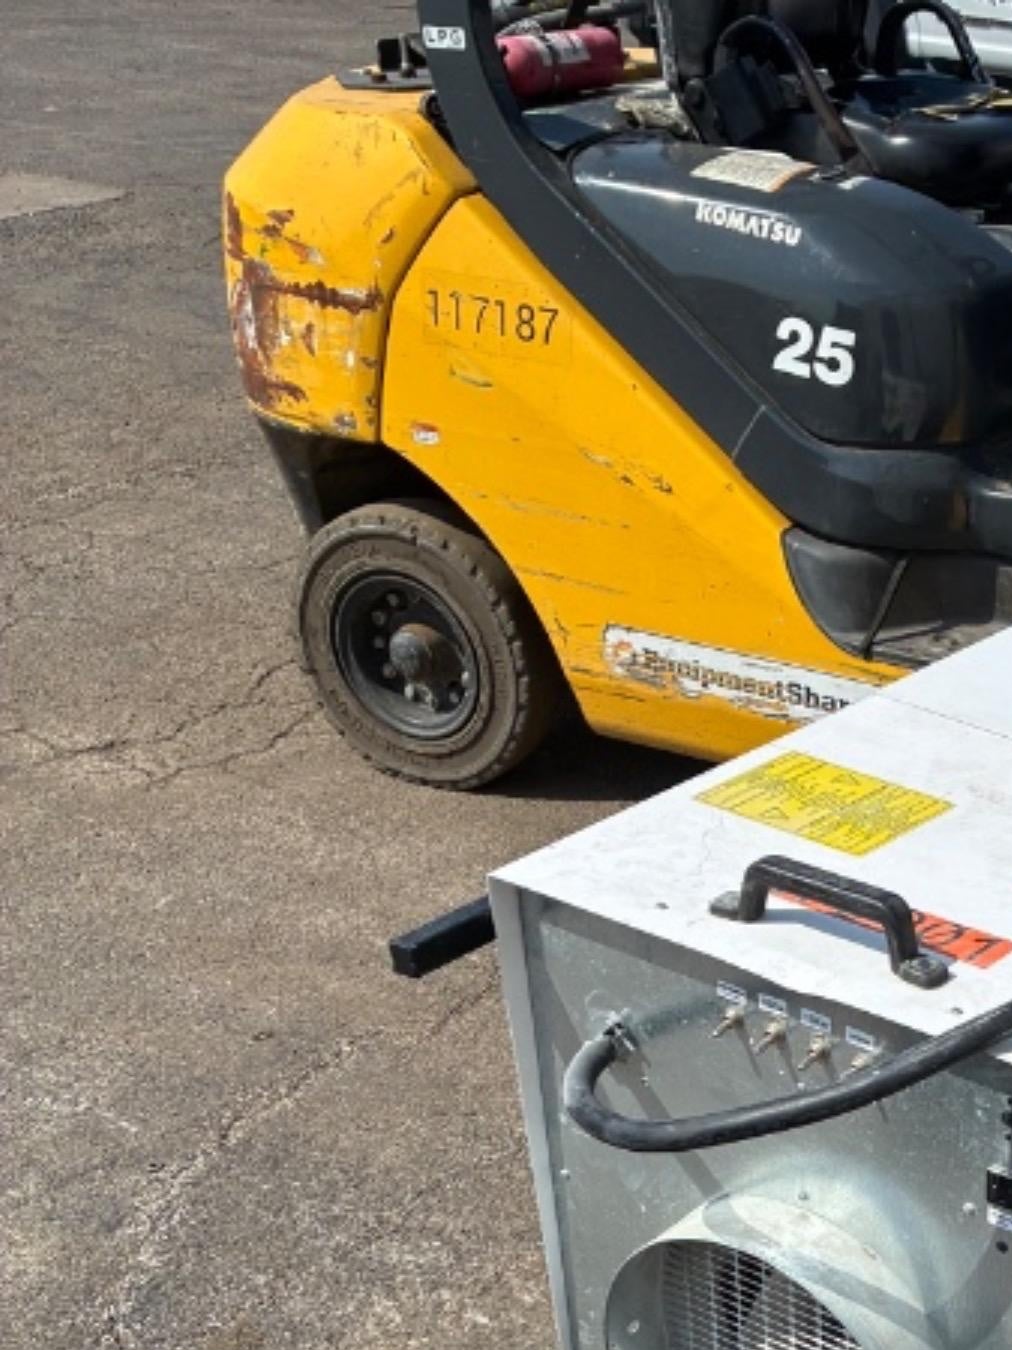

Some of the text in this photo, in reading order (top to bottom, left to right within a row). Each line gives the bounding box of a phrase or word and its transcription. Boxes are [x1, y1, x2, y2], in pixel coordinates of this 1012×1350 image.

[425, 28, 462, 46] LPG
[694, 199, 802, 247] KOMATSU
[427, 289, 559, 346] 117187
[771, 316, 856, 387] 25
